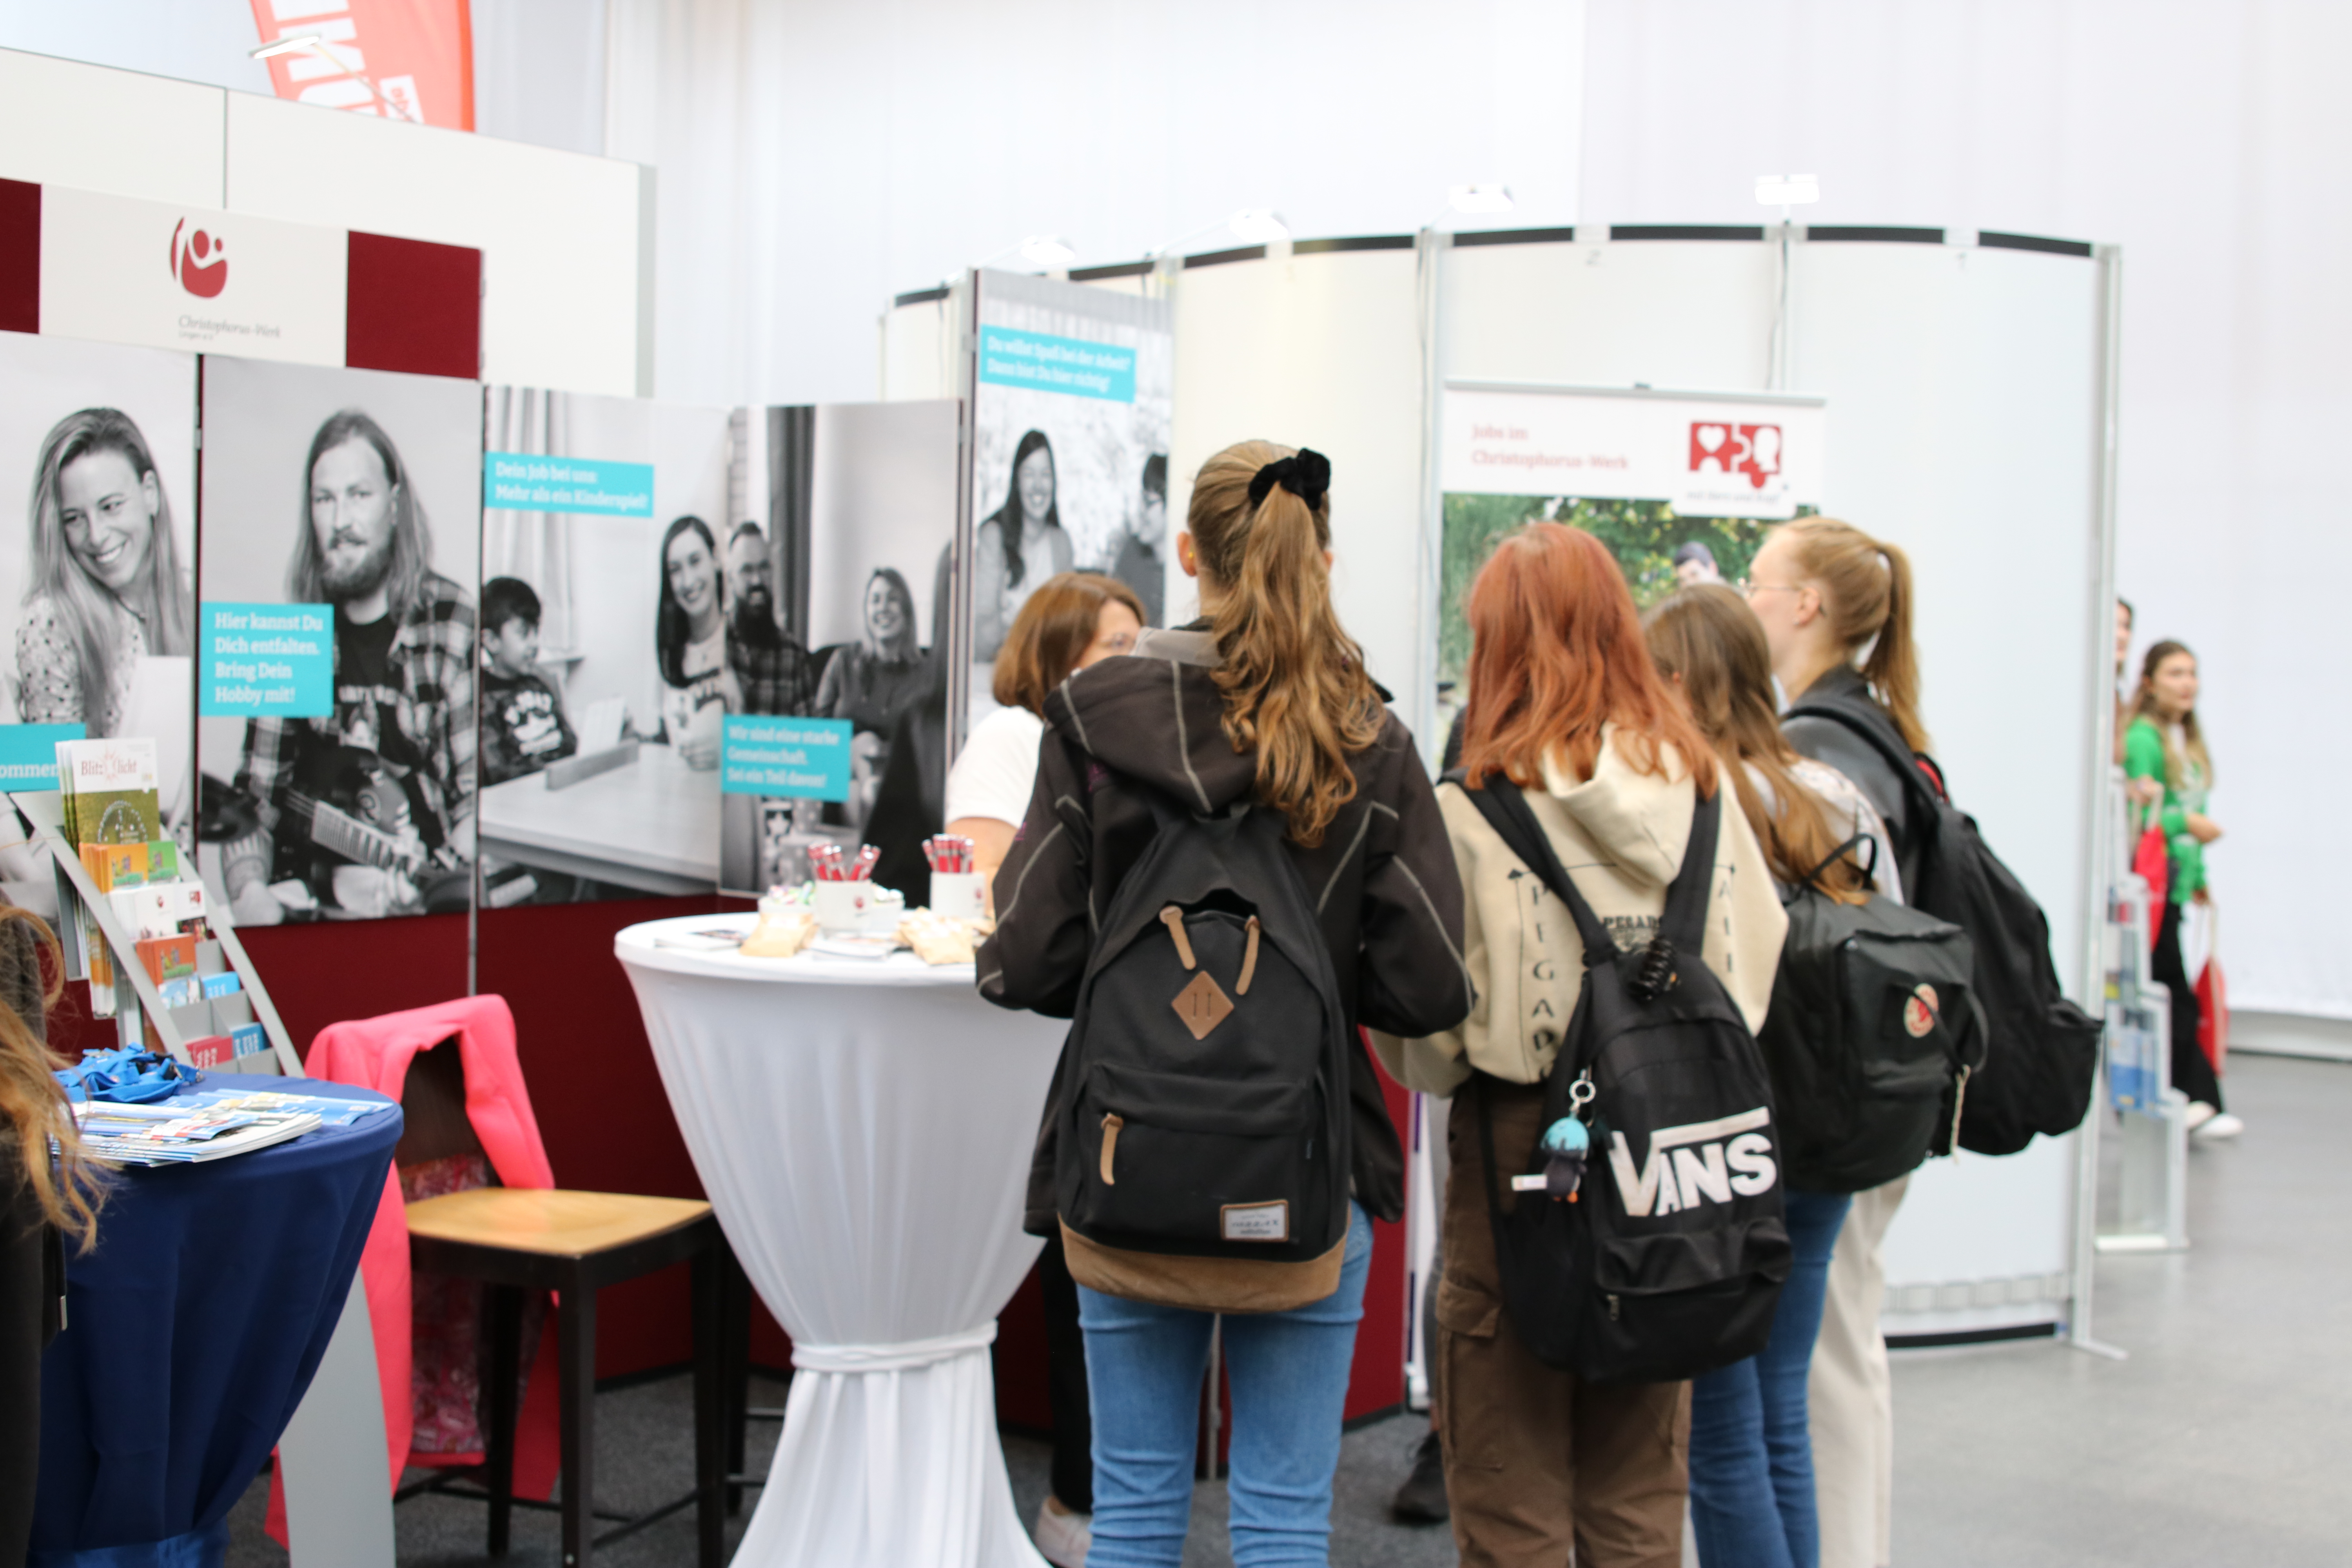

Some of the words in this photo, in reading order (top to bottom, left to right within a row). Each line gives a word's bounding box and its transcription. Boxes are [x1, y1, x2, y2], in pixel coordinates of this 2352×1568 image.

[178, 314, 281, 338] Christophorus-Werk
[1472, 424, 1503, 442] Jobs
[1508, 425, 1528, 440] im
[1472, 450, 1628, 472] Christophorus-Werk
[496, 462, 526, 478] Dein
[528, 463, 548, 481] Job
[551, 465, 570, 481] bei
[496, 484, 530, 501] Mehr
[532, 486, 550, 502] als
[552, 488, 572, 503] ein
[216, 612, 247, 629] Hier
[250, 612, 299, 630] kannst
[302, 615, 323, 631] Du
[215, 636, 248, 653] Dich
[251, 637, 320, 655] entfalten.
[215, 661, 256, 682] Bring
[259, 661, 292, 678] Dein
[215, 686, 263, 707] Hobby
[265, 686, 295, 703] mit!
[81, 759, 103, 777] Blitz
[1608, 1105, 1777, 1217] VANS
